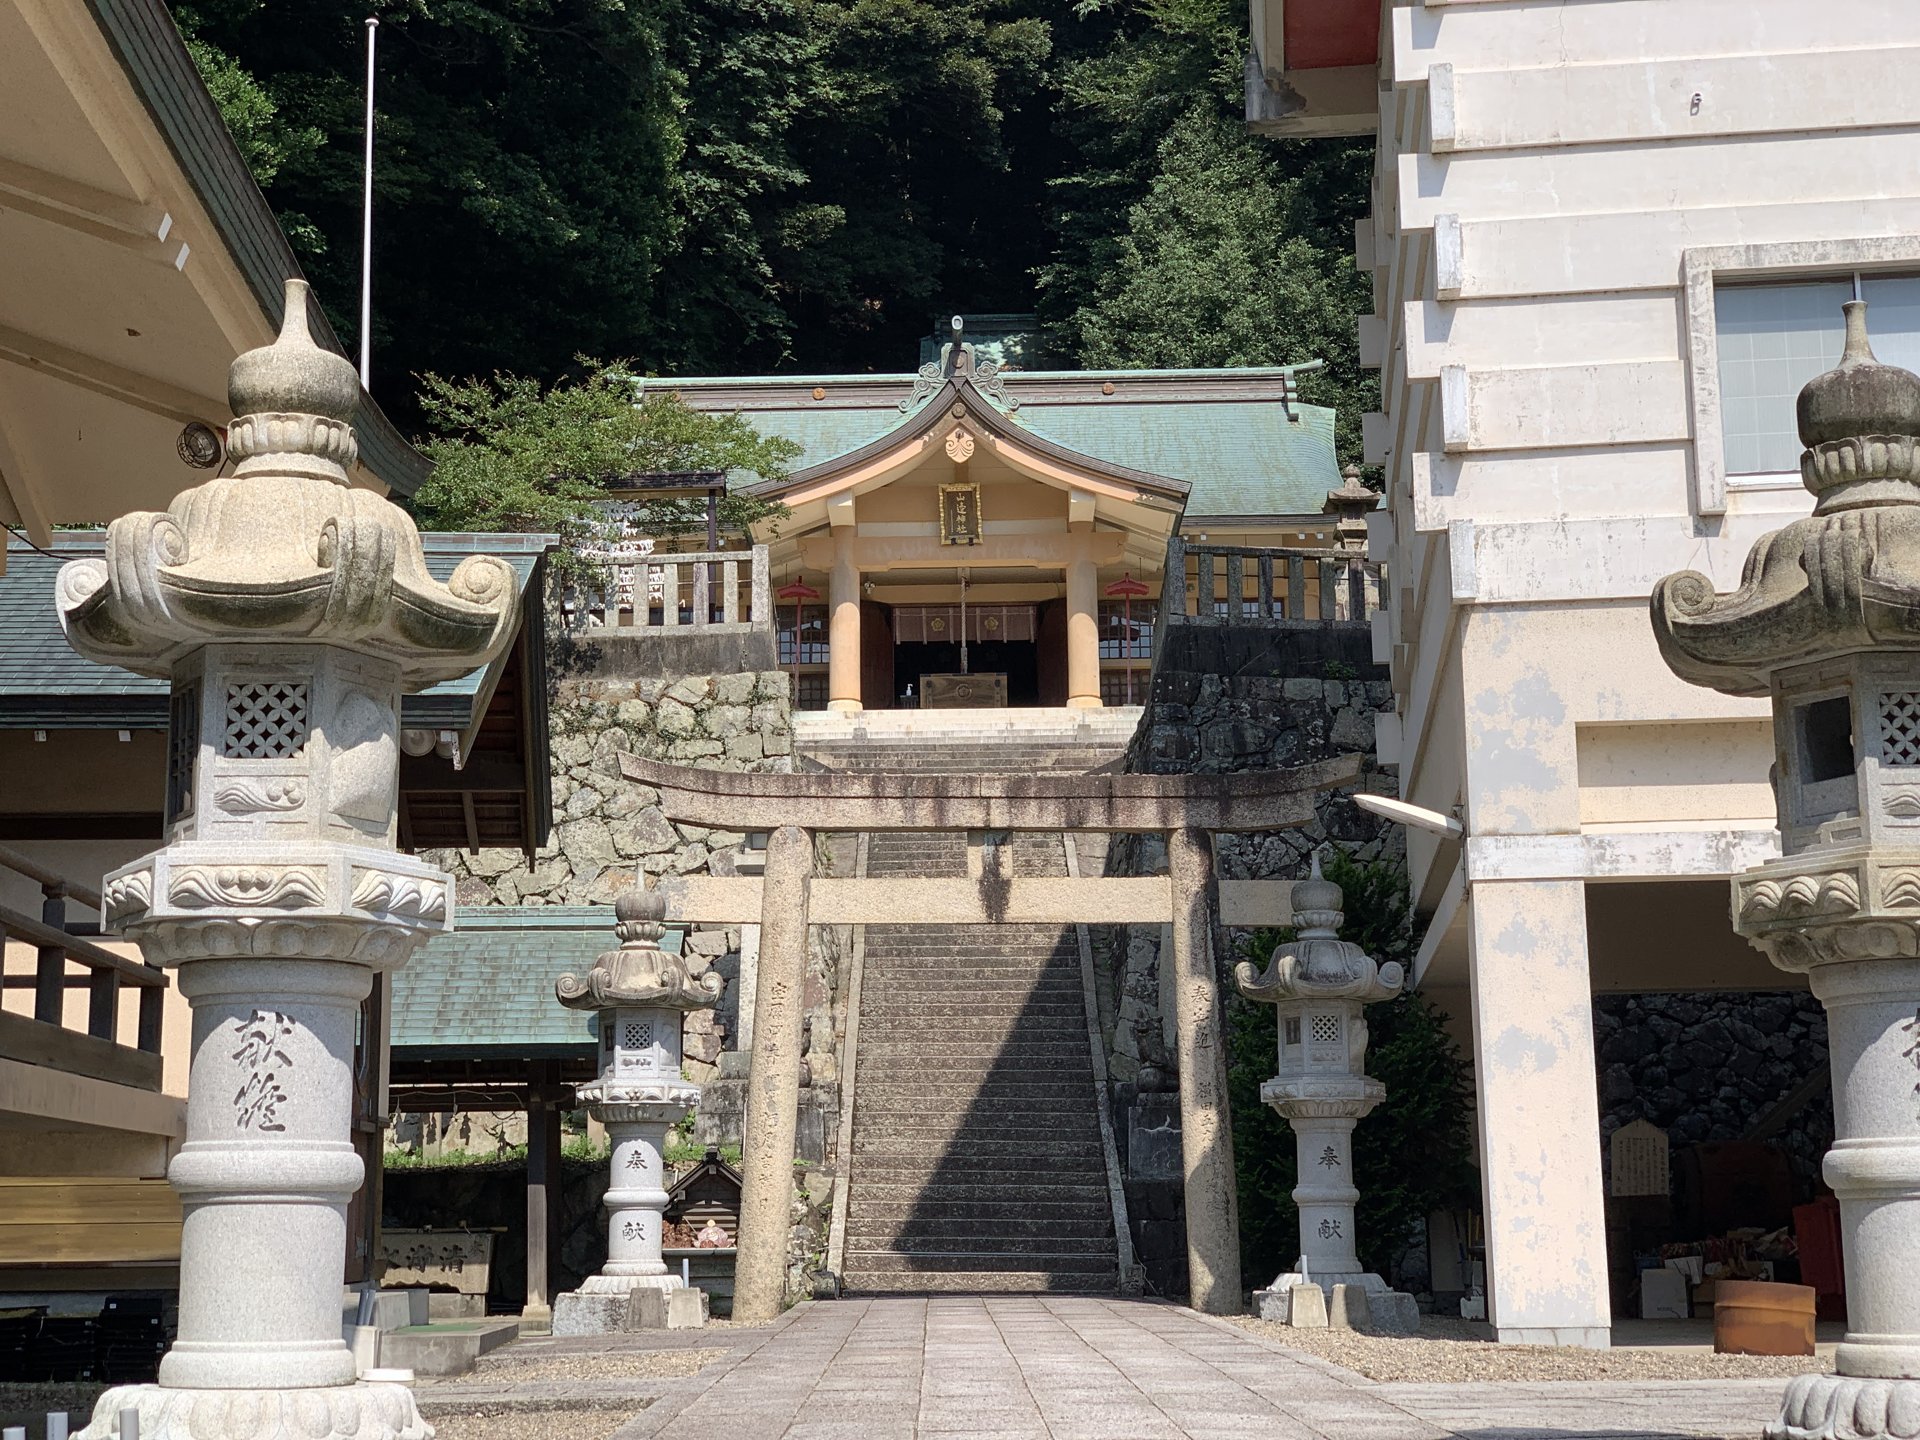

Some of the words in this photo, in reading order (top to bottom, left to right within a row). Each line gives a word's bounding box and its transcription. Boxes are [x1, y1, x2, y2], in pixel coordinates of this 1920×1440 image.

[625, 1149, 648, 1172] 奉
[1317, 1145, 1341, 1171] 奉
[622, 1221, 646, 1242] 献
[1318, 1218, 1343, 1240] 献
